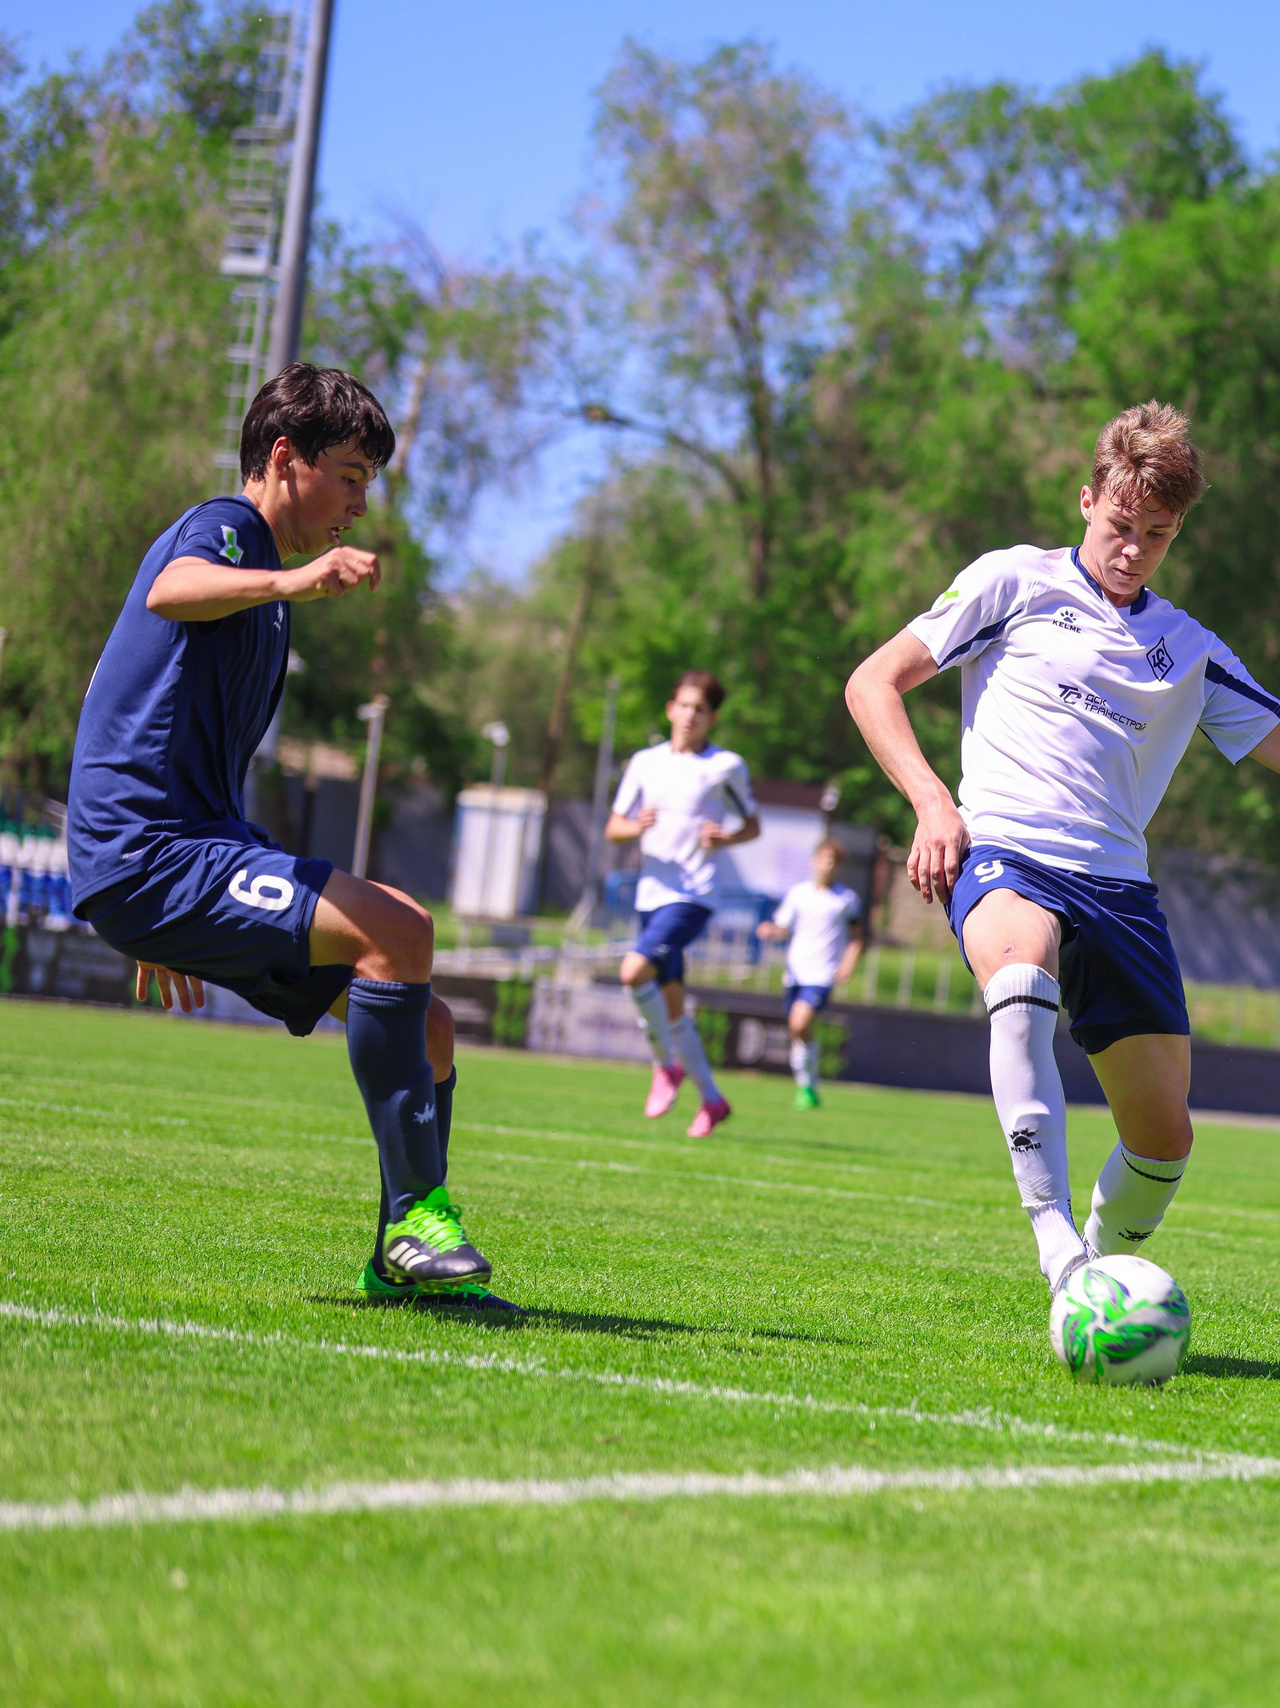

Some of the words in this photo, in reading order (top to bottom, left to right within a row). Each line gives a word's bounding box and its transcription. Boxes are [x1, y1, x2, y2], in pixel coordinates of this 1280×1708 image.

[1052, 619, 1082, 634] KELME
[1084, 693, 1107, 706] ДСК
[1084, 702, 1147, 732] ТРАНССТРОЙ
[228, 869, 294, 911] 6
